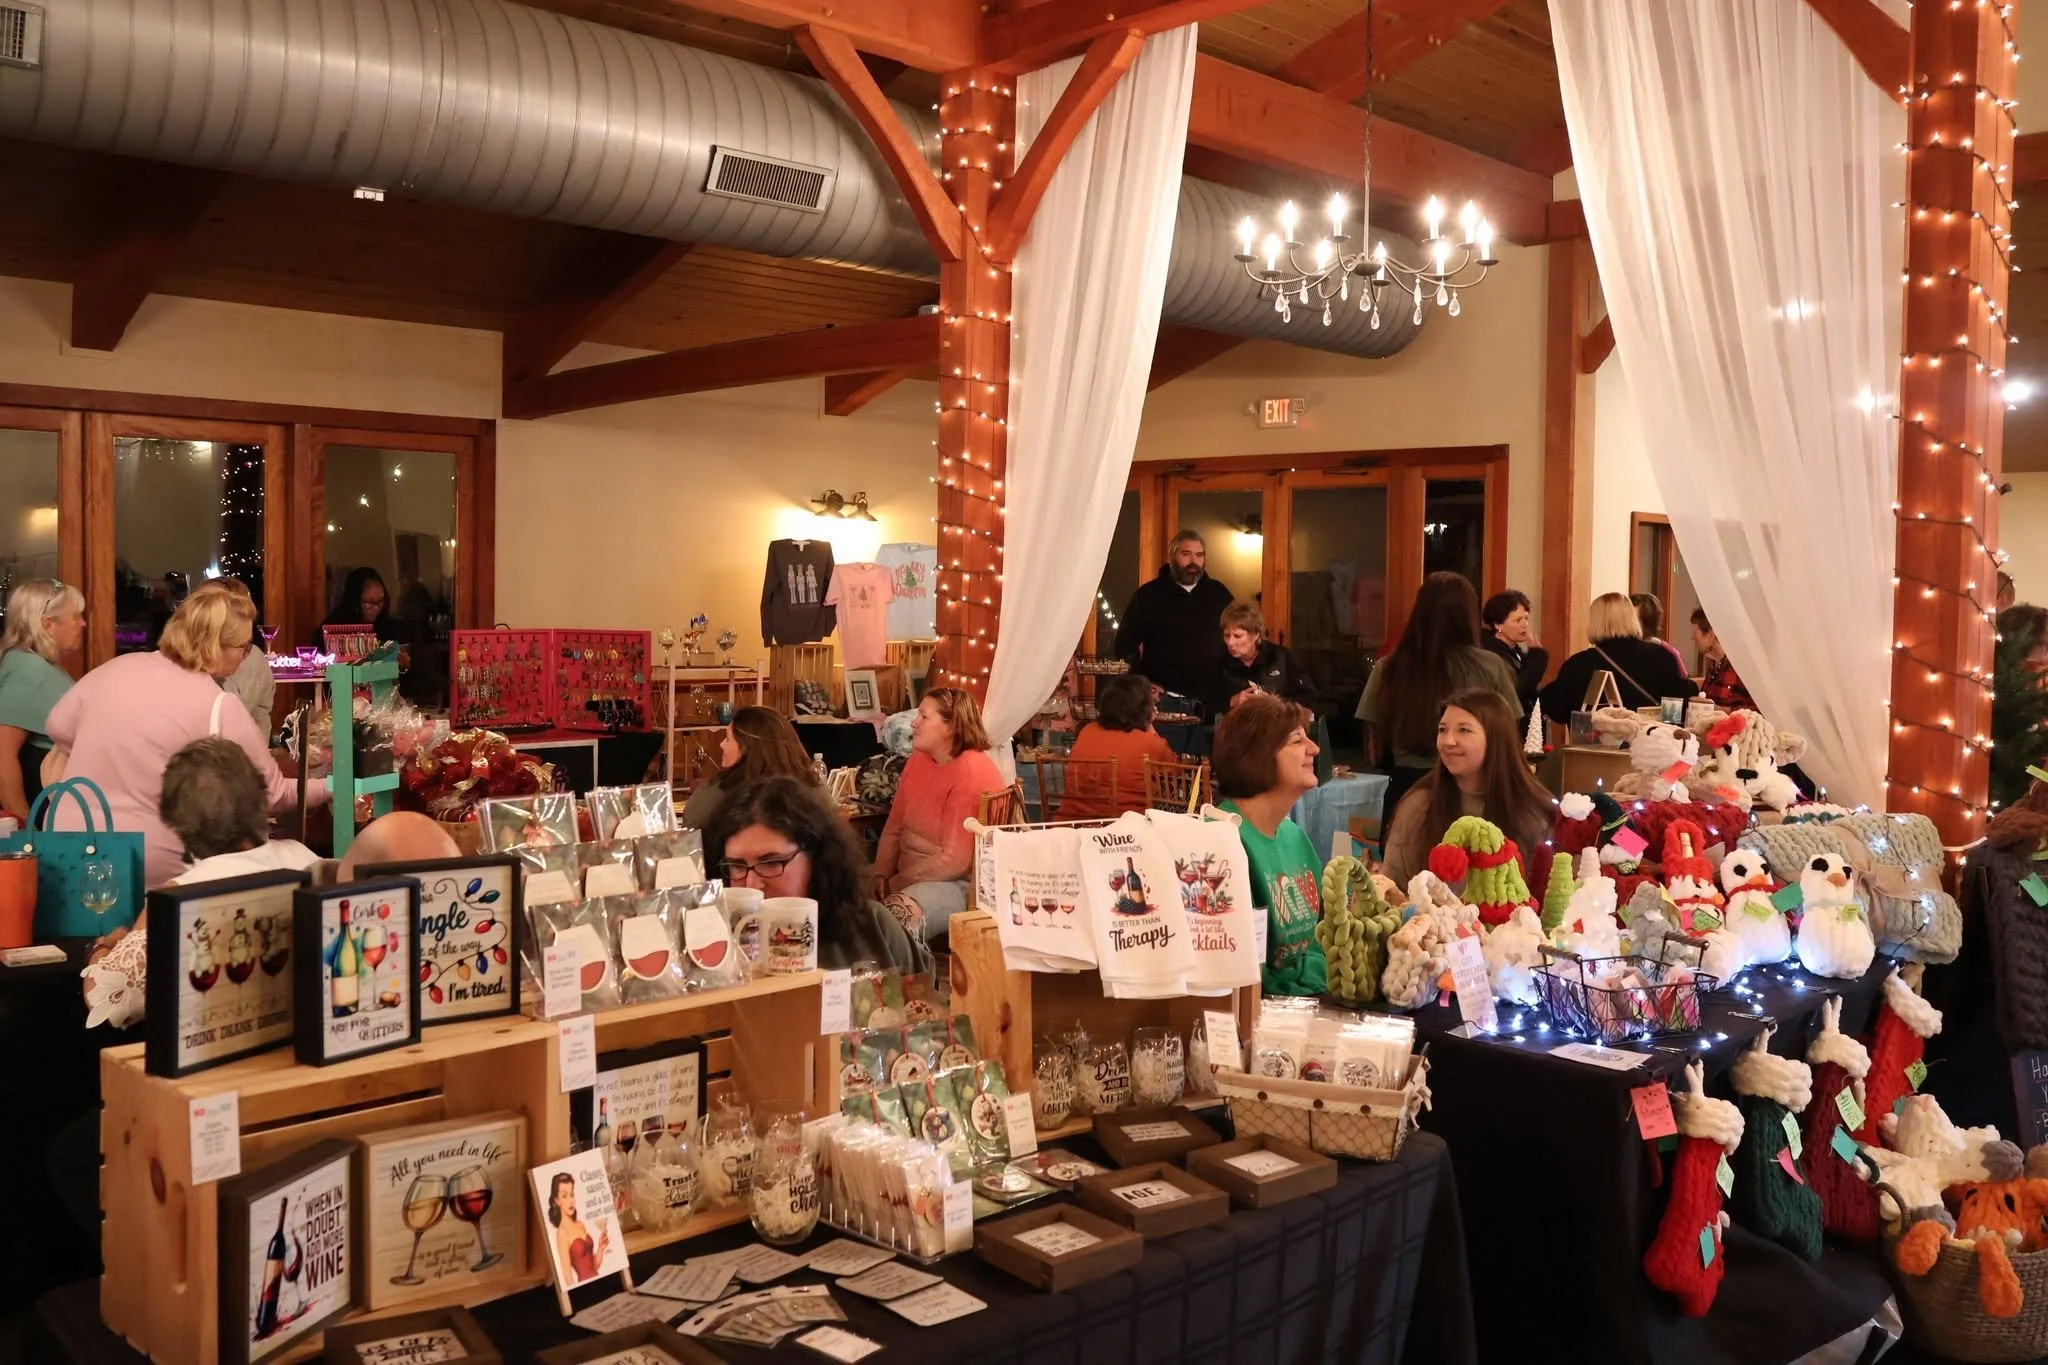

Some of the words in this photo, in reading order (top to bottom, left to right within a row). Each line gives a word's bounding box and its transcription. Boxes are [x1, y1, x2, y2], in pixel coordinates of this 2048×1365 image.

[1264, 399, 1290, 424] EXIT
[1093, 833, 1135, 847] Wine
[1116, 845, 1143, 854] FRIENDS
[1119, 919, 1140, 927] BETTER
[1142, 916, 1161, 925] THAN
[428, 943, 438, 958] of
[441, 940, 457, 955] the
[461, 940, 483, 953] way
[1109, 925, 1176, 952] Therapy
[448, 983, 469, 1003] I'm
[472, 976, 507, 998] tired.
[185, 1030, 216, 1049] DRINK
[220, 1020, 253, 1039] DRANK
[350, 1017, 370, 1031] FOR
[391, 1160, 410, 1188] All
[413, 1152, 435, 1175] you
[438, 1139, 468, 1159] need
[468, 1145, 482, 1158] in
[482, 1142, 512, 1166] life
[305, 1189, 332, 1219] WHEN
[333, 1184, 343, 1205] IN
[306, 1205, 341, 1243] DOUBT
[306, 1239, 321, 1261] ADD
[323, 1226, 344, 1251] MORE
[305, 1243, 344, 1292] WINE
